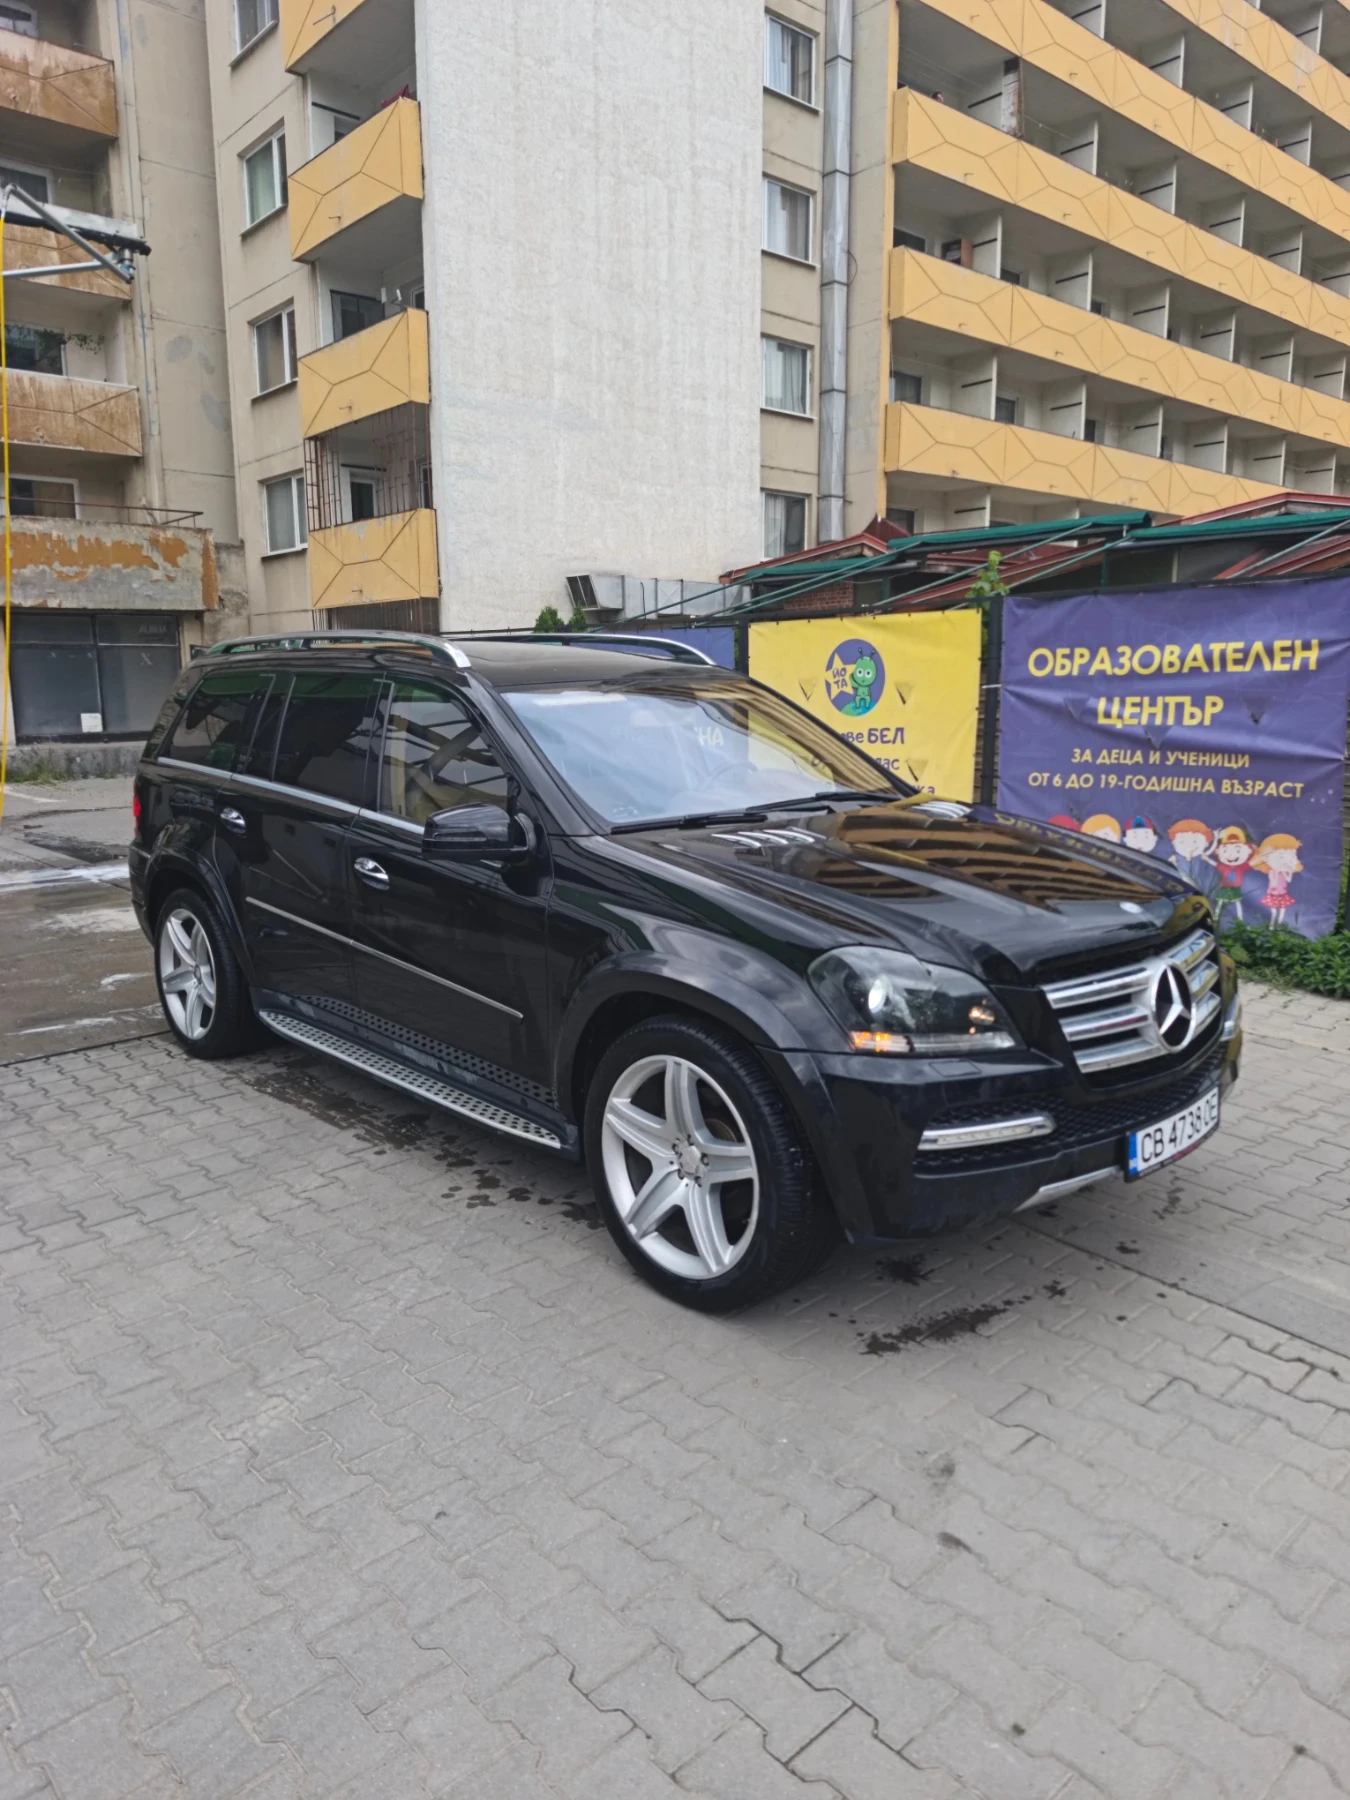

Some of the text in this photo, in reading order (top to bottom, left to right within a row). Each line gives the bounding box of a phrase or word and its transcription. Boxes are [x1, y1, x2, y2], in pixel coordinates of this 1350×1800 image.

[1028, 639, 1319, 677] ОБРАЗОВАТЕЛЕН
[1097, 696, 1224, 728] ЦЕНТЪР
[867, 727, 905, 745] БЕЛ
[1071, 748, 1250, 769] ЗА ДЕЦА И УЧЕНИЦИ
[1028, 772, 1304, 799] ОТ 6 ДО 19-ГОДИШНА ВЪЗРАСТ
